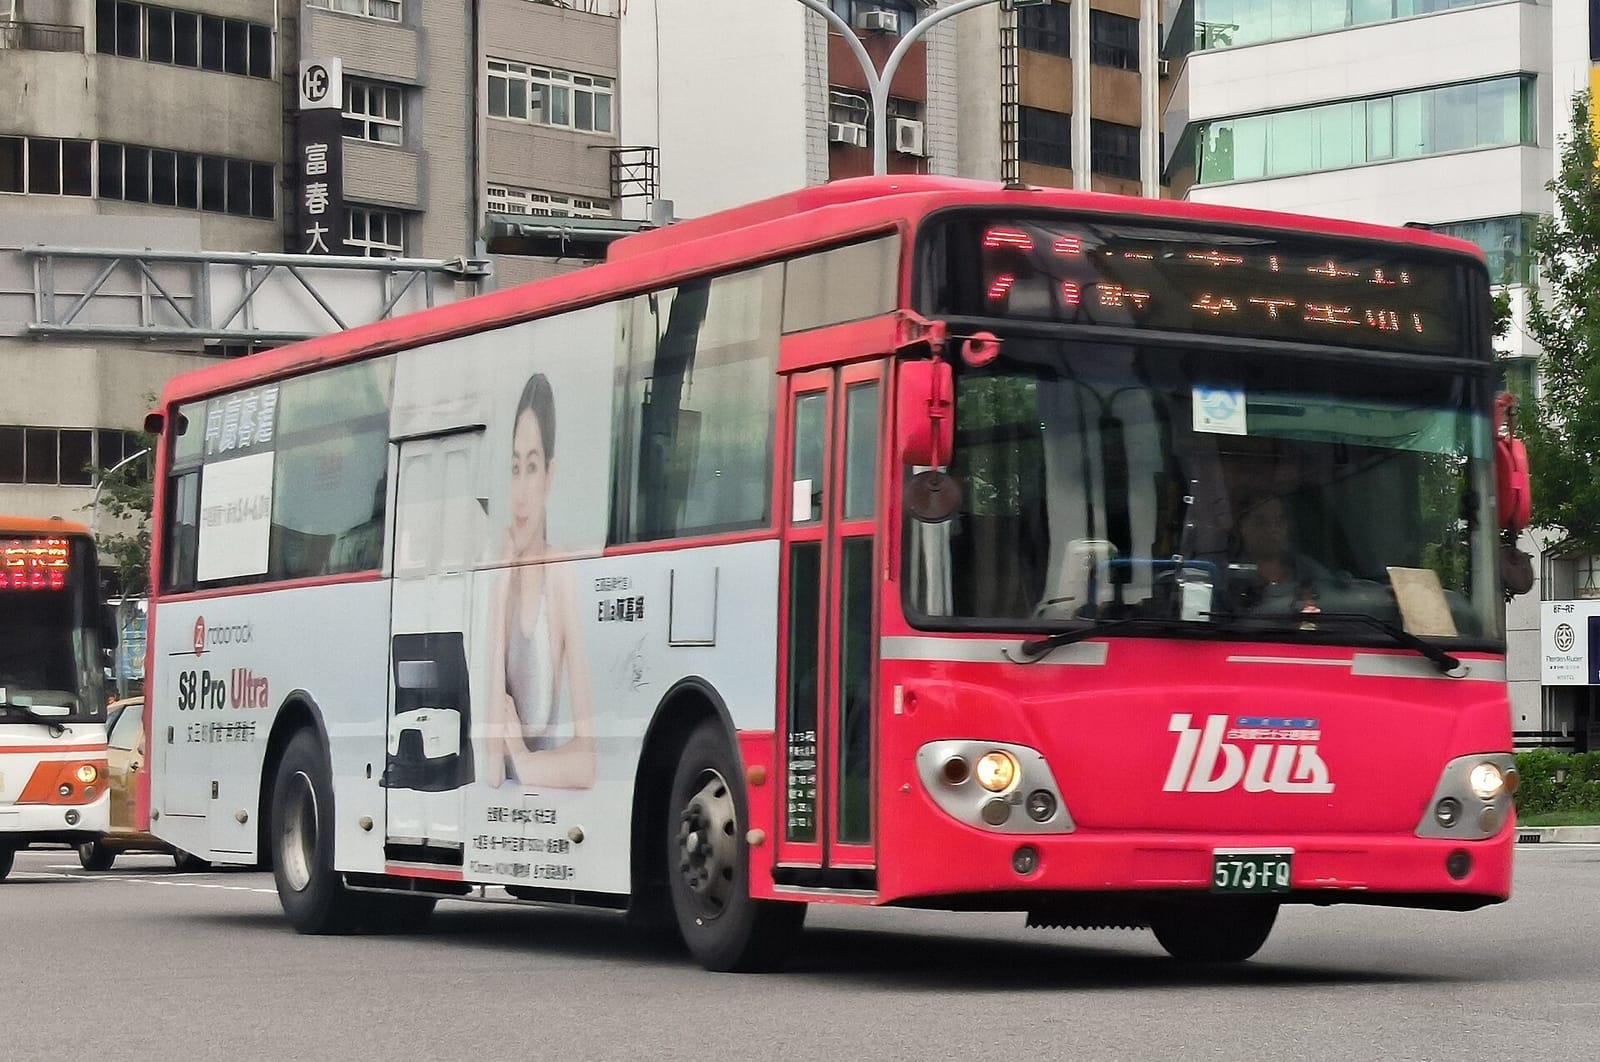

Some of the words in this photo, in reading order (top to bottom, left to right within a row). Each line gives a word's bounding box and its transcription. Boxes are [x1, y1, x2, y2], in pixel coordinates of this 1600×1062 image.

[304, 142, 330, 254] 富春大
[178, 670, 198, 711] S8
[200, 670, 226, 710] Pro
[230, 667, 269, 710] Ultra
[1214, 861, 1291, 889] 573-FQ
